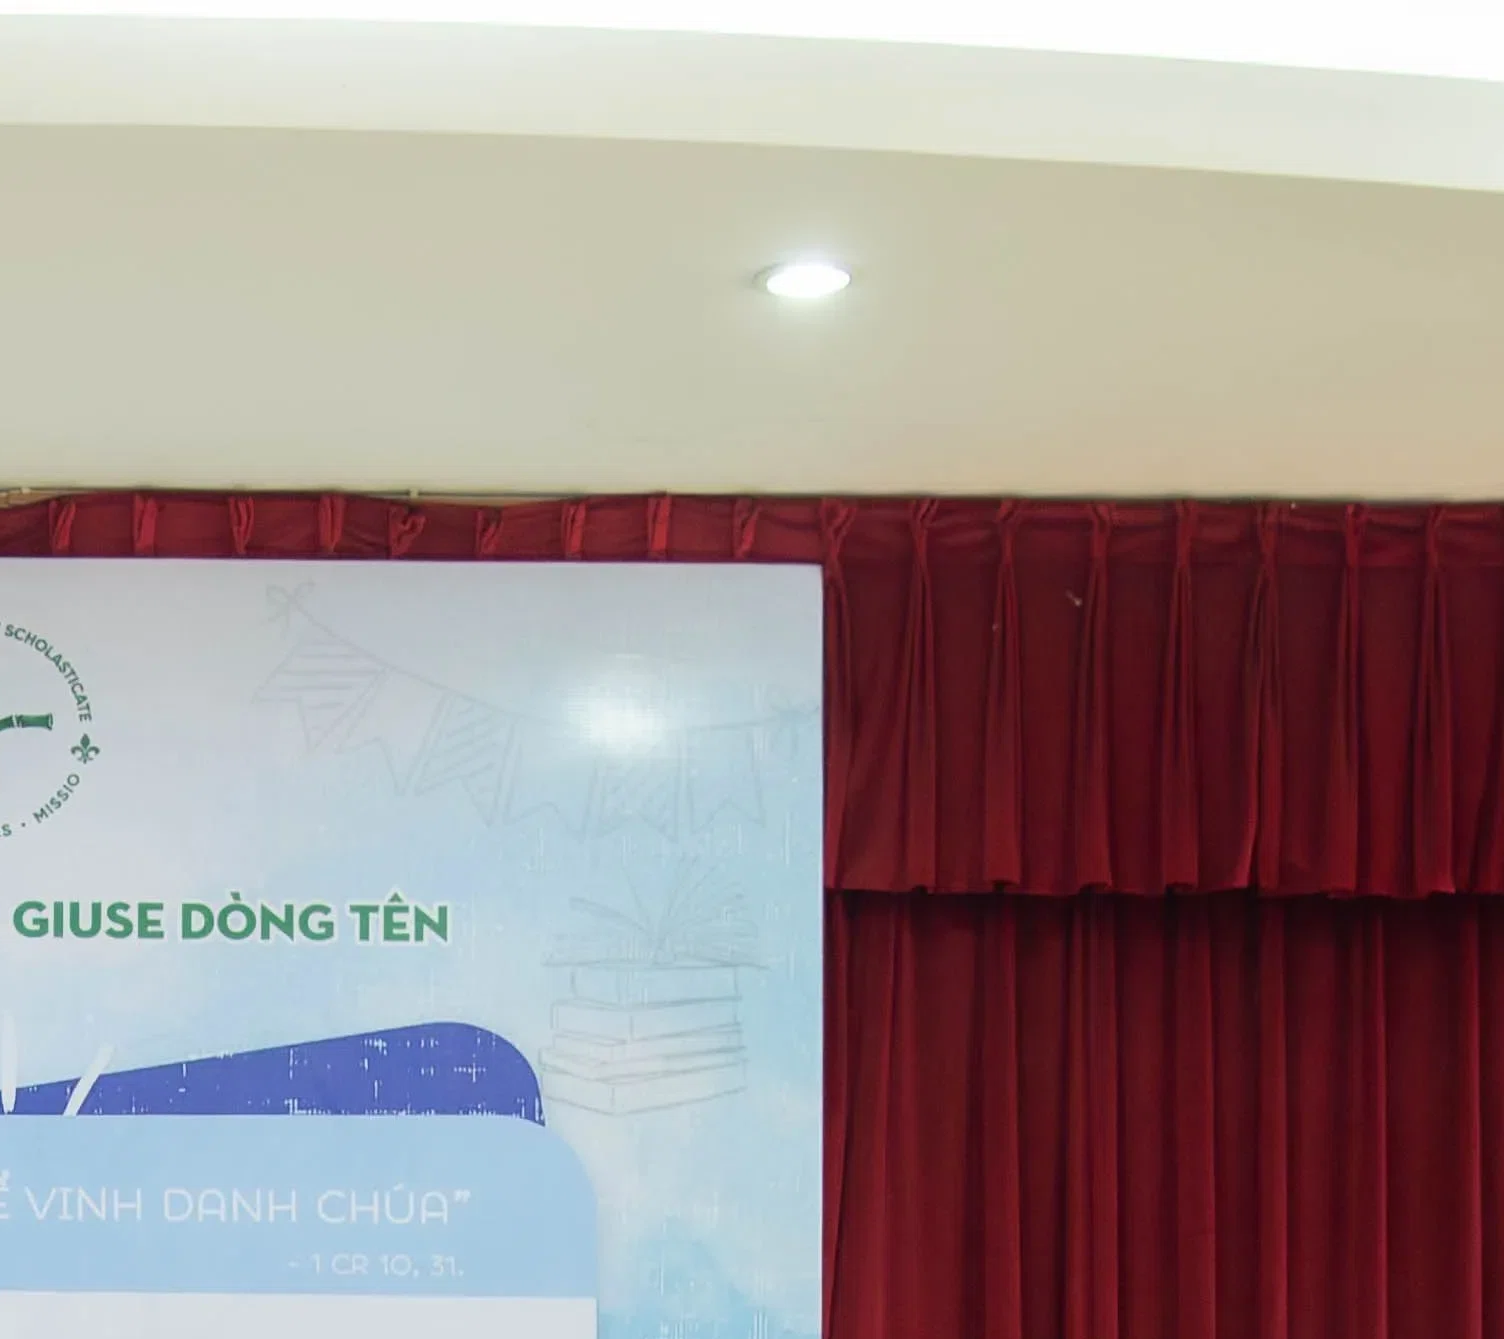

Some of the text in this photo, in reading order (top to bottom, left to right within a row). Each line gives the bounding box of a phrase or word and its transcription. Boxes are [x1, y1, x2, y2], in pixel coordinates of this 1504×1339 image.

[4, 624, 92, 722] SCHOLASTICATE
[33, 773, 80, 824] MISSIO
[13, 900, 165, 940] GIUSE
[181, 891, 335, 942] DÒNG
[349, 891, 448, 943] TÊN
[24, 1186, 142, 1221] VINH
[163, 1187, 297, 1223] DANH
[331, 1254, 368, 1276] CR
